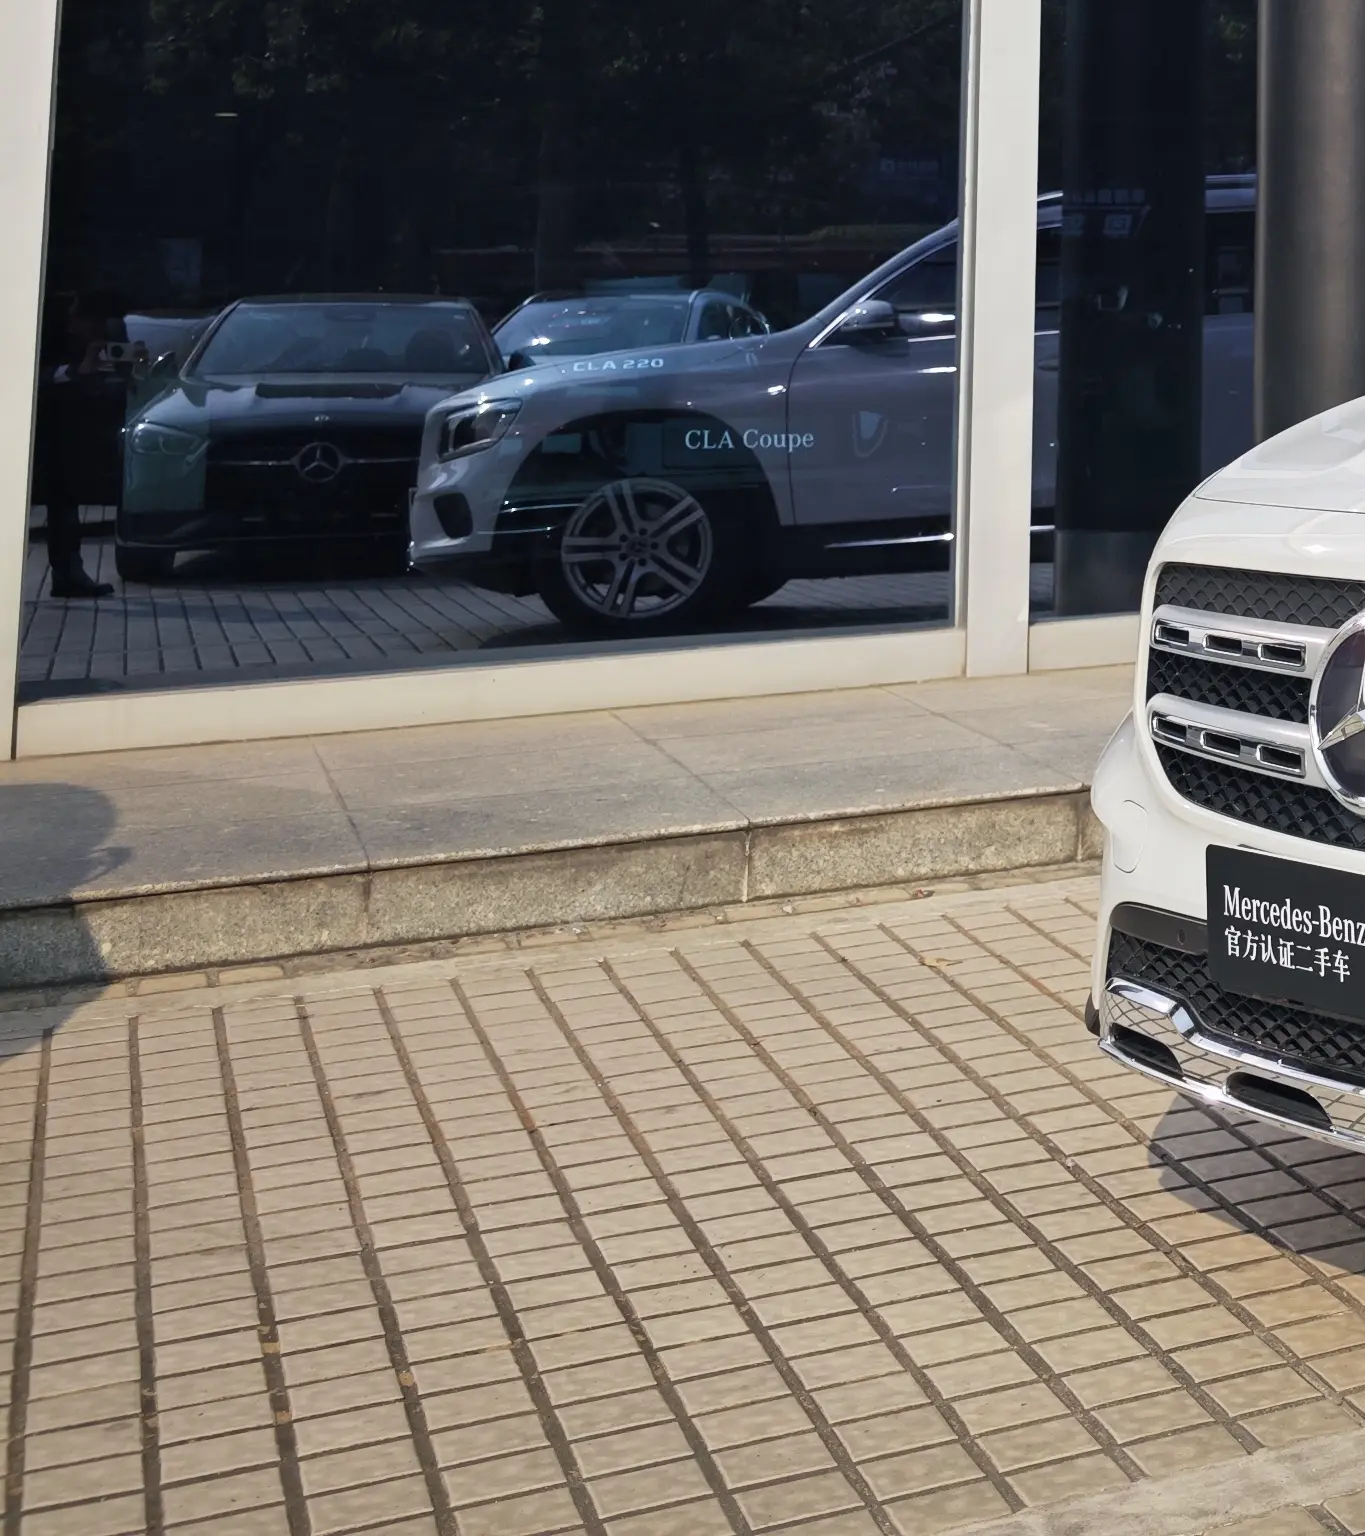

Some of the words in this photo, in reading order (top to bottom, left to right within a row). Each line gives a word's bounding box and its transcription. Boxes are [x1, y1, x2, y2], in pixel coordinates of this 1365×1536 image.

[573, 360, 617, 372] CLA
[622, 358, 664, 370] 220
[685, 430, 735, 450] CLA
[743, 429, 814, 453] Coupe
[1224, 925, 1351, 982] 官方认证二手车
